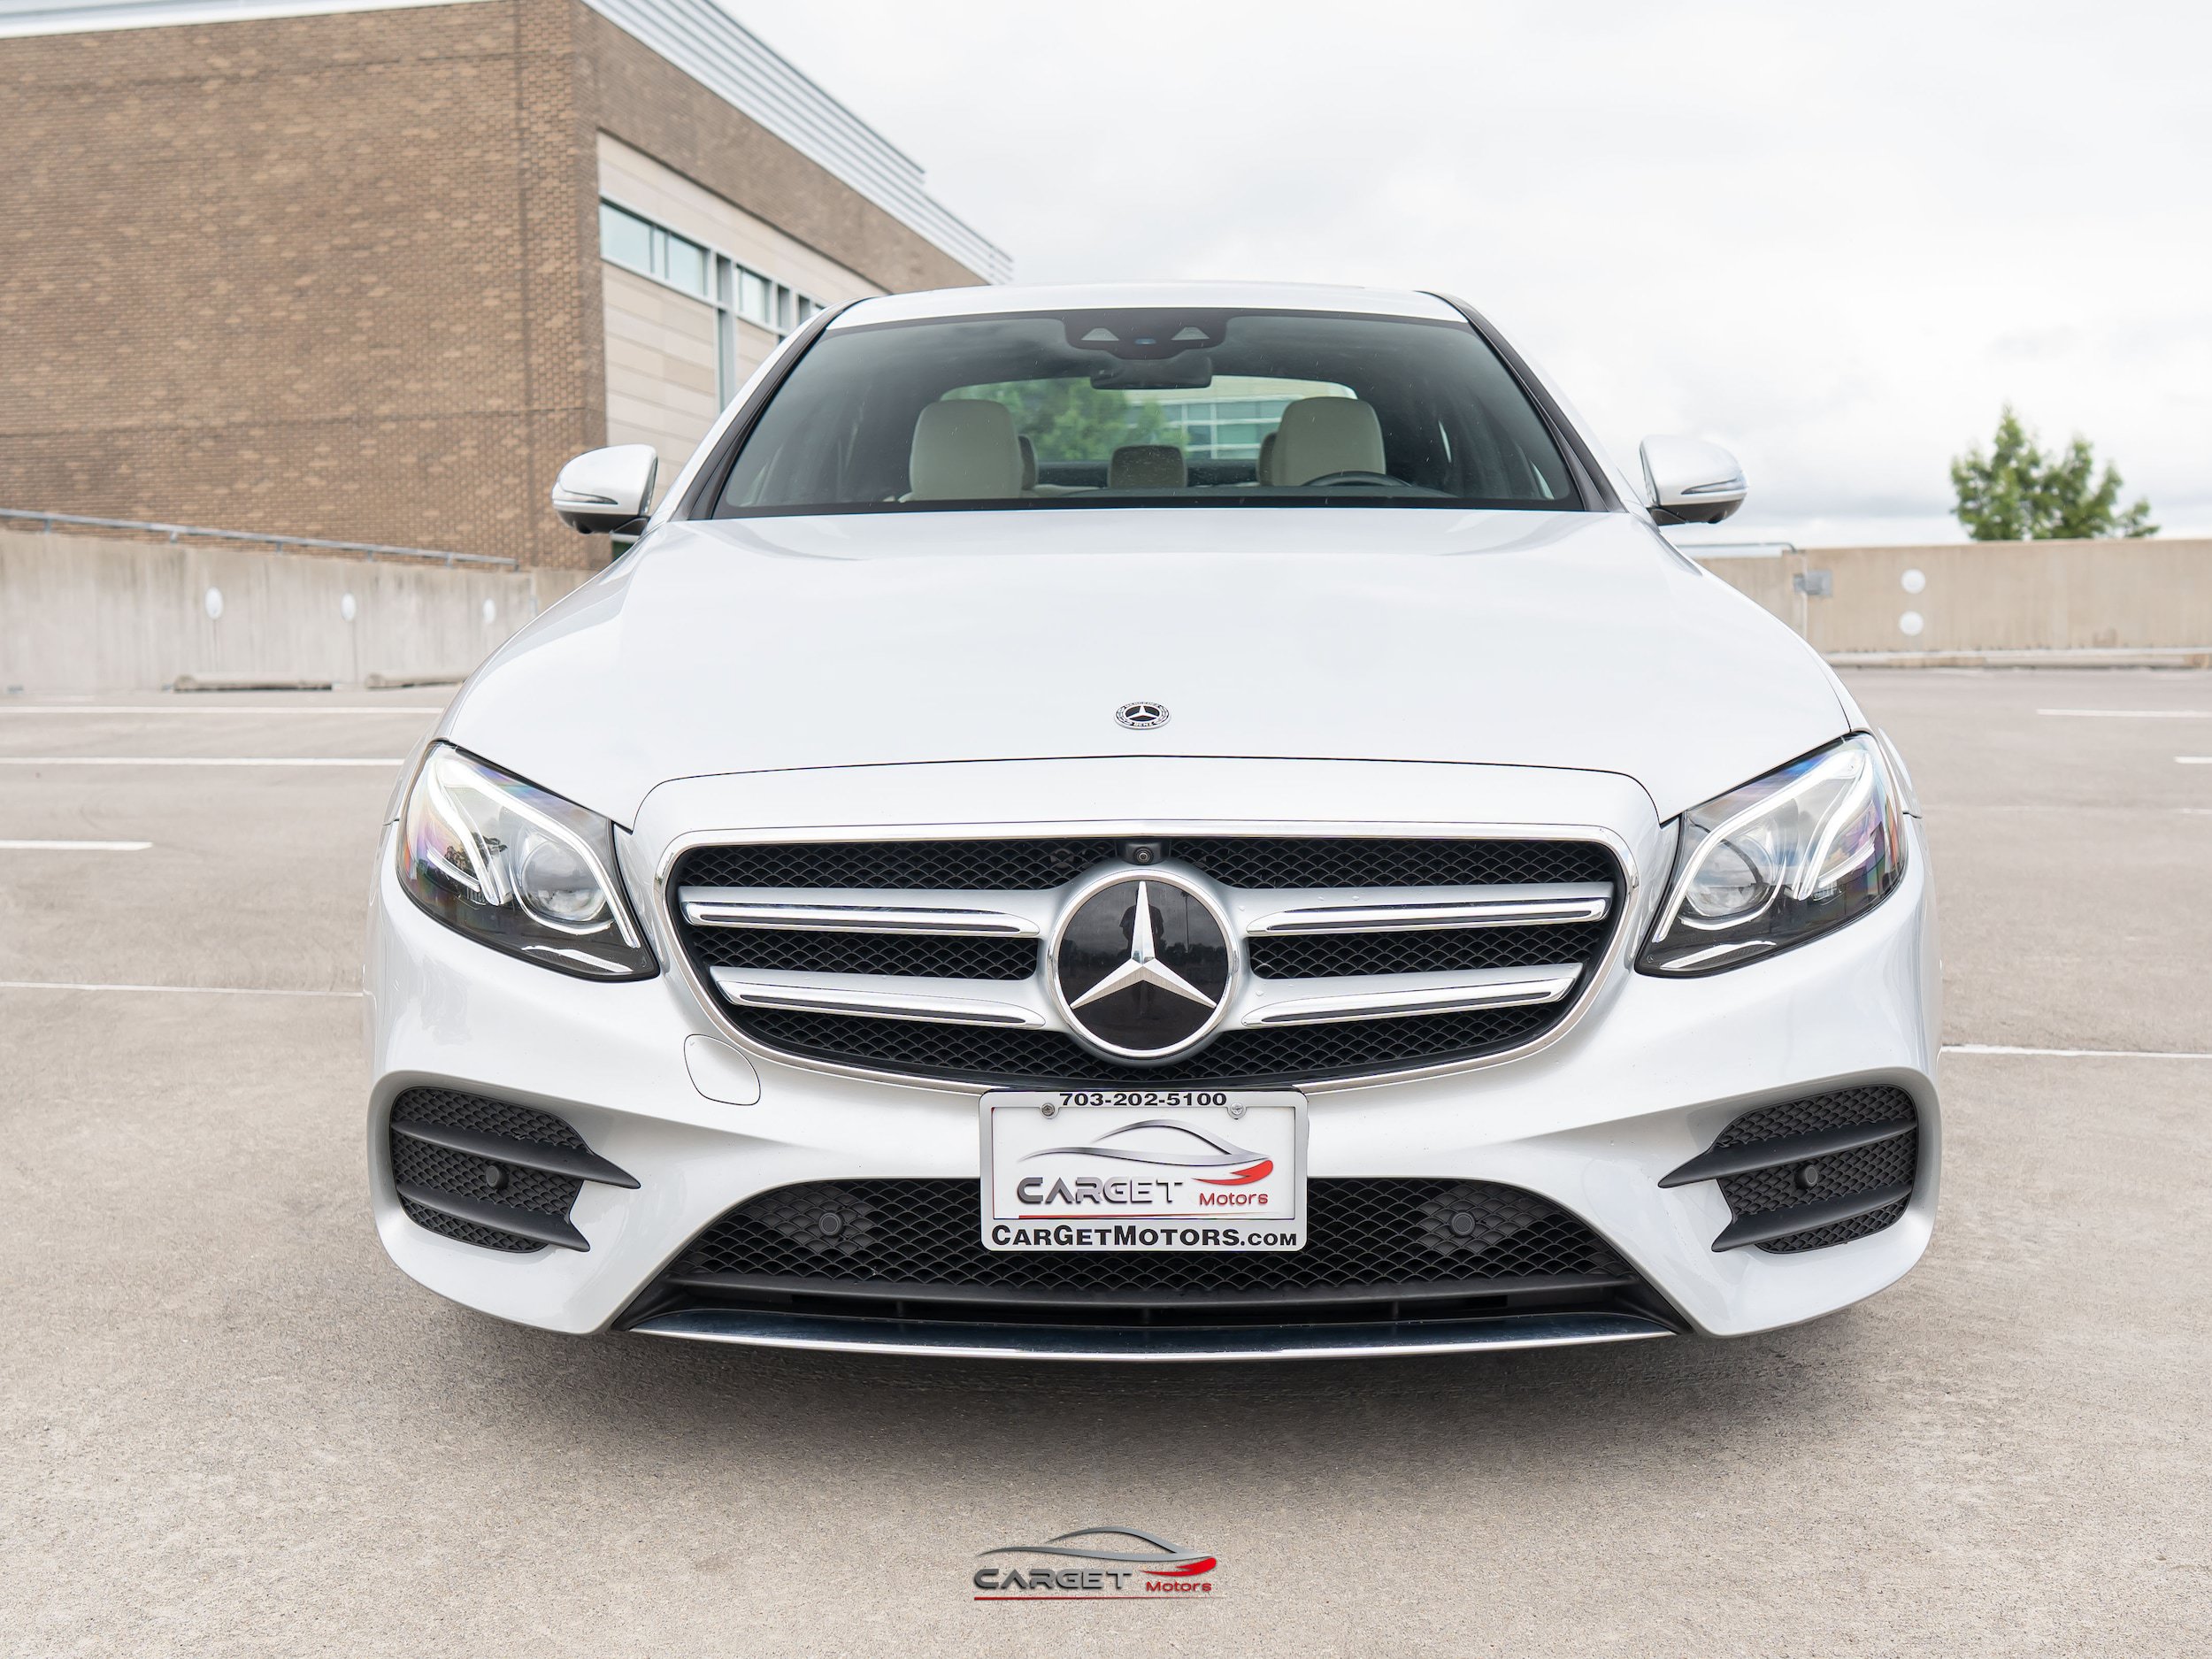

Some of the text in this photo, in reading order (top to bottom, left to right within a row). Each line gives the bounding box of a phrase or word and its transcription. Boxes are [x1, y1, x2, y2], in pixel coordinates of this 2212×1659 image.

[1059, 1093, 1227, 1106] 703-202-5100
[1017, 1177, 1269, 1206] CARGET Motors
